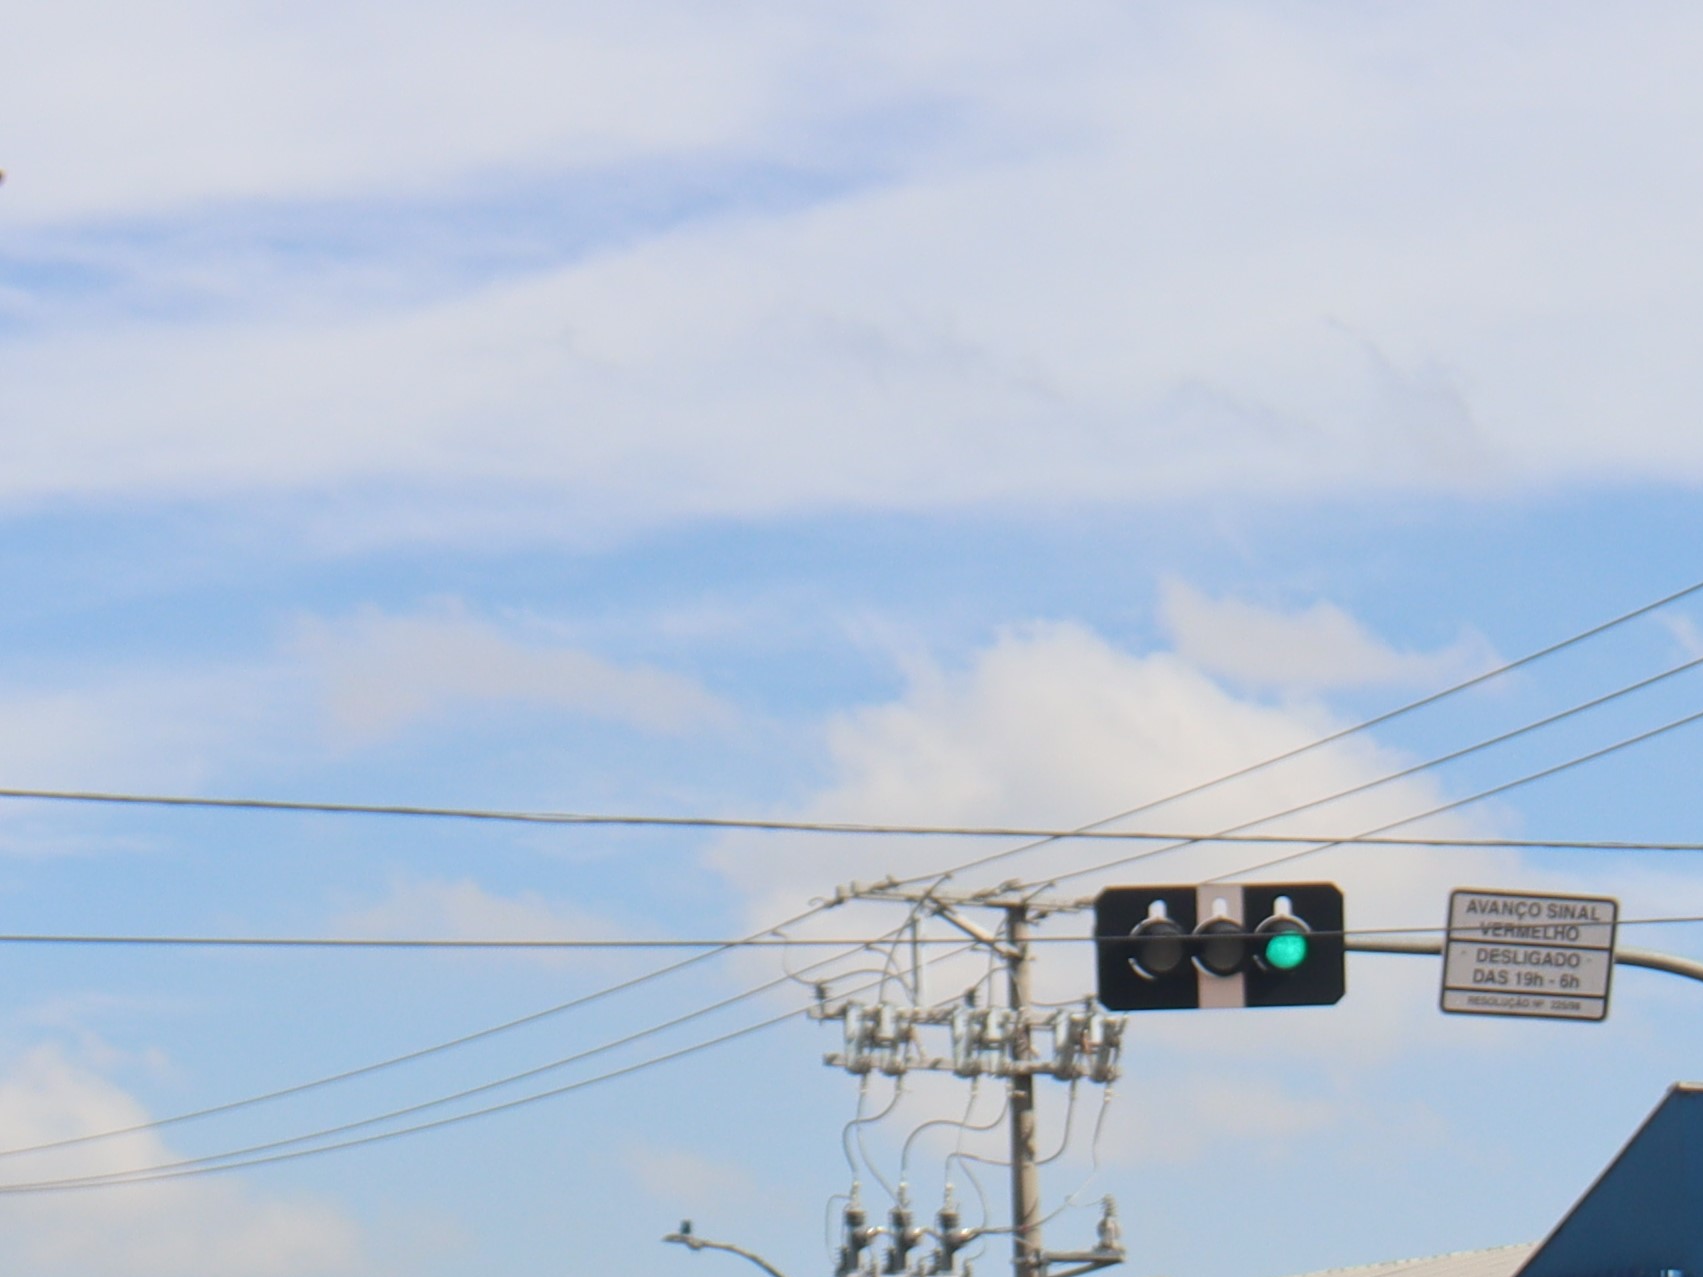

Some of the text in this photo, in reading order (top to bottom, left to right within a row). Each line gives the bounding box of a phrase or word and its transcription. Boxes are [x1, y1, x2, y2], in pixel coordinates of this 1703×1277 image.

[1467, 899, 1601, 921] AVANÇO SINAL
[1480, 921, 1580, 942] VERMELHO
[1476, 948, 1581, 968] DESLIGADO
[1473, 968, 1508, 985] DAS
[1515, 972, 1543, 986] 19h
[1559, 974, 1580, 988] 6h
